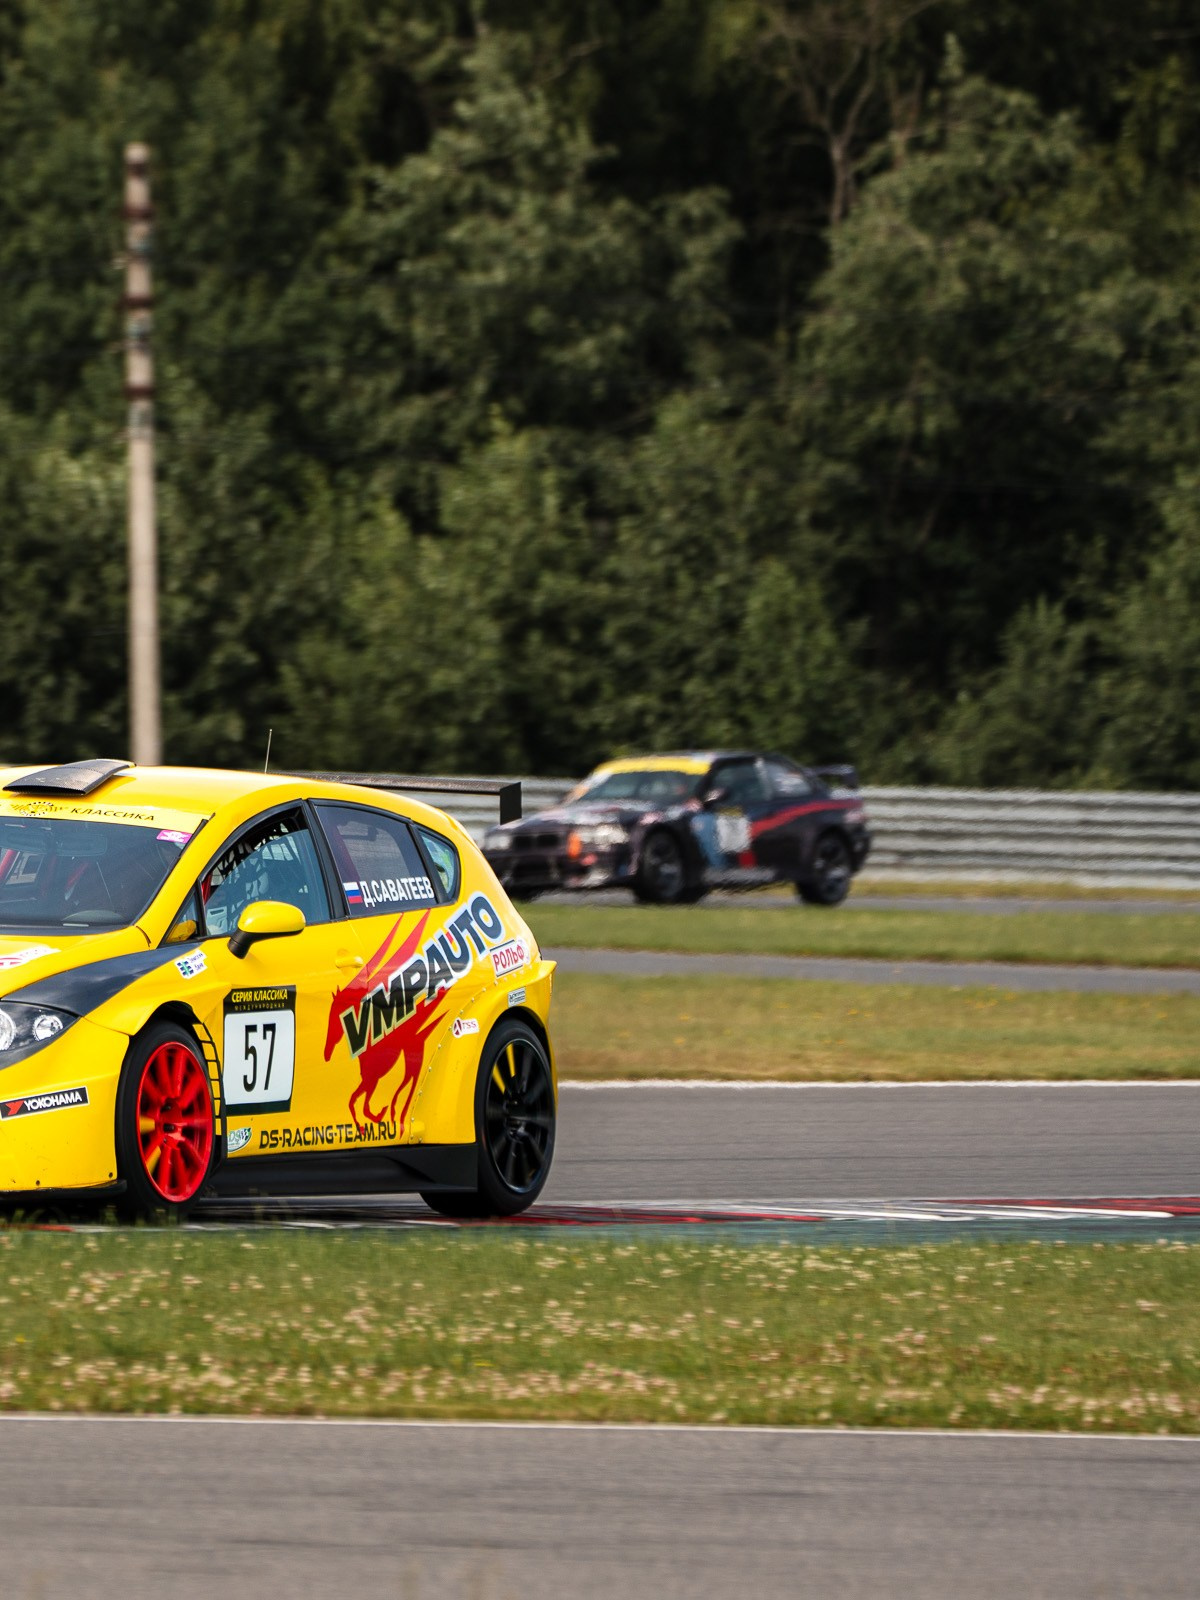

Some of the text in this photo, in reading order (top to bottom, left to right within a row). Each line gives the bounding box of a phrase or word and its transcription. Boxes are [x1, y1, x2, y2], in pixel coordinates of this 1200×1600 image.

[70, 807, 155, 821] КЛАССИКА
[360, 876, 435, 908] Д.САВАТЕЕВ
[492, 944, 525, 972] РОЛЬФ
[341, 893, 504, 1056] VMPAUTO
[231, 989, 288, 1003] СЕРИЯ КЛАССИКА
[243, 1023, 276, 1092] 57
[24, 1091, 82, 1111] YOKOHAMA
[259, 1121, 397, 1149] DS-RACING-TEAM.RU
